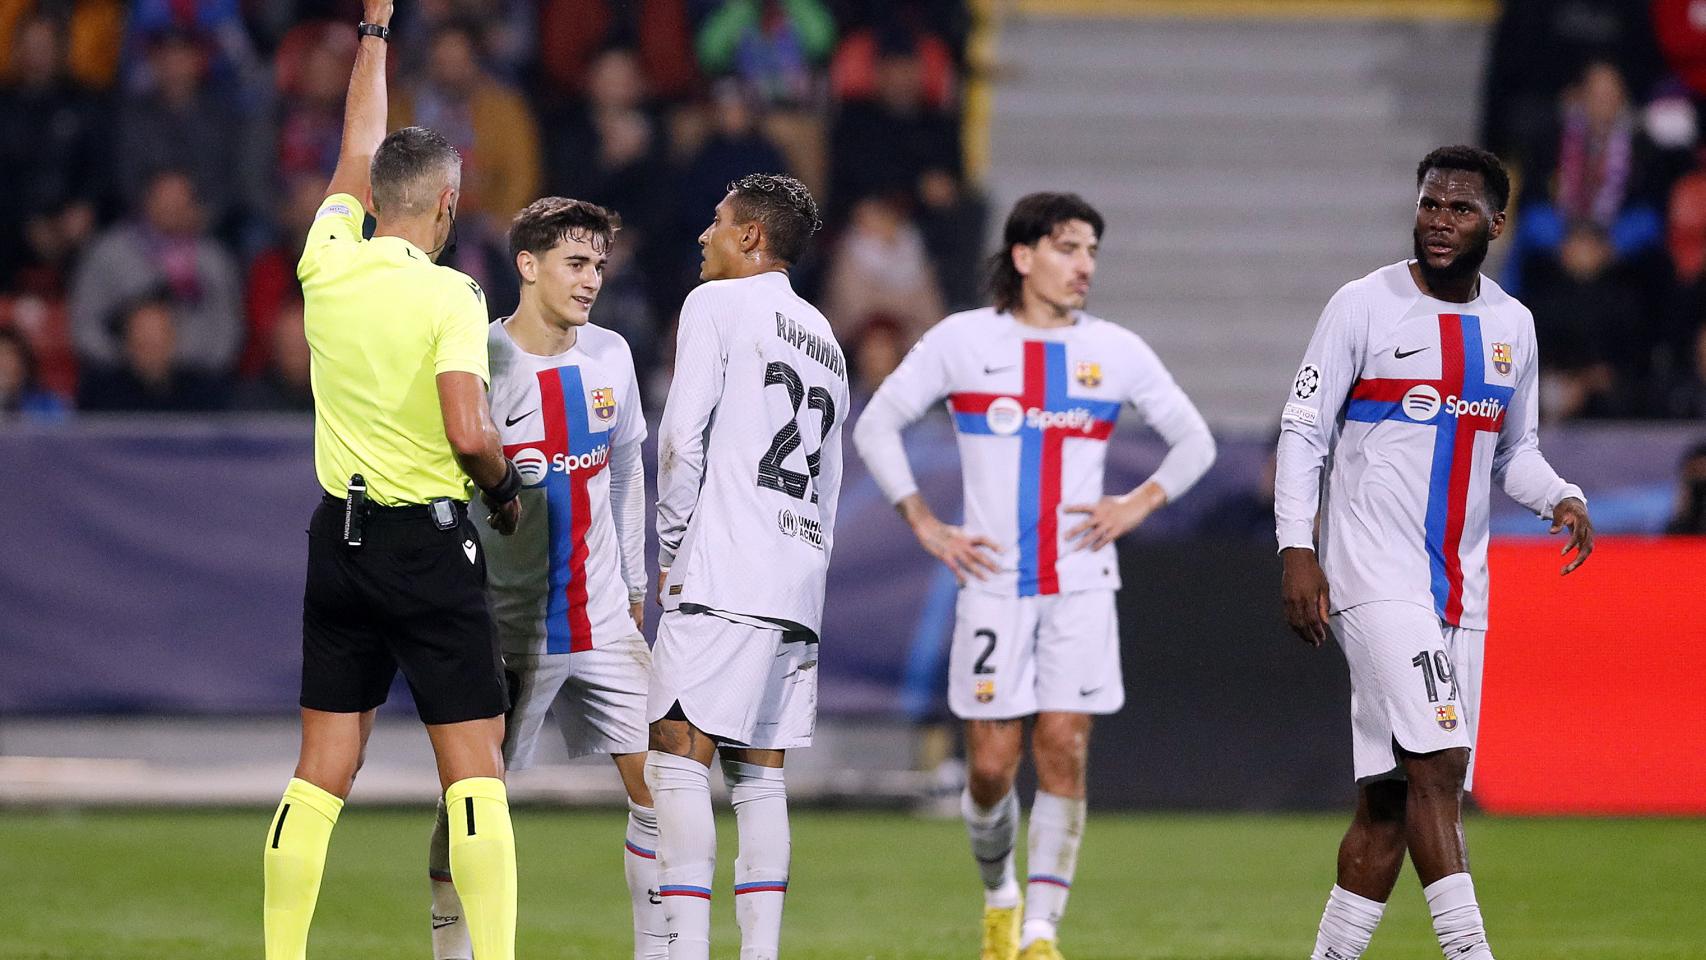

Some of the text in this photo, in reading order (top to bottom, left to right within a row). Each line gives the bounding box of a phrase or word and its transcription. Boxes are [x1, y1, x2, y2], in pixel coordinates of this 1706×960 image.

[775, 311, 845, 382] RAPHINHA
[1026, 406, 1094, 434] Spotify
[1445, 395, 1505, 421] Spotify
[552, 444, 610, 475] Spotify
[799, 527, 822, 545] ACNU
[973, 628, 997, 675] 2
[1411, 650, 1457, 703] 19
